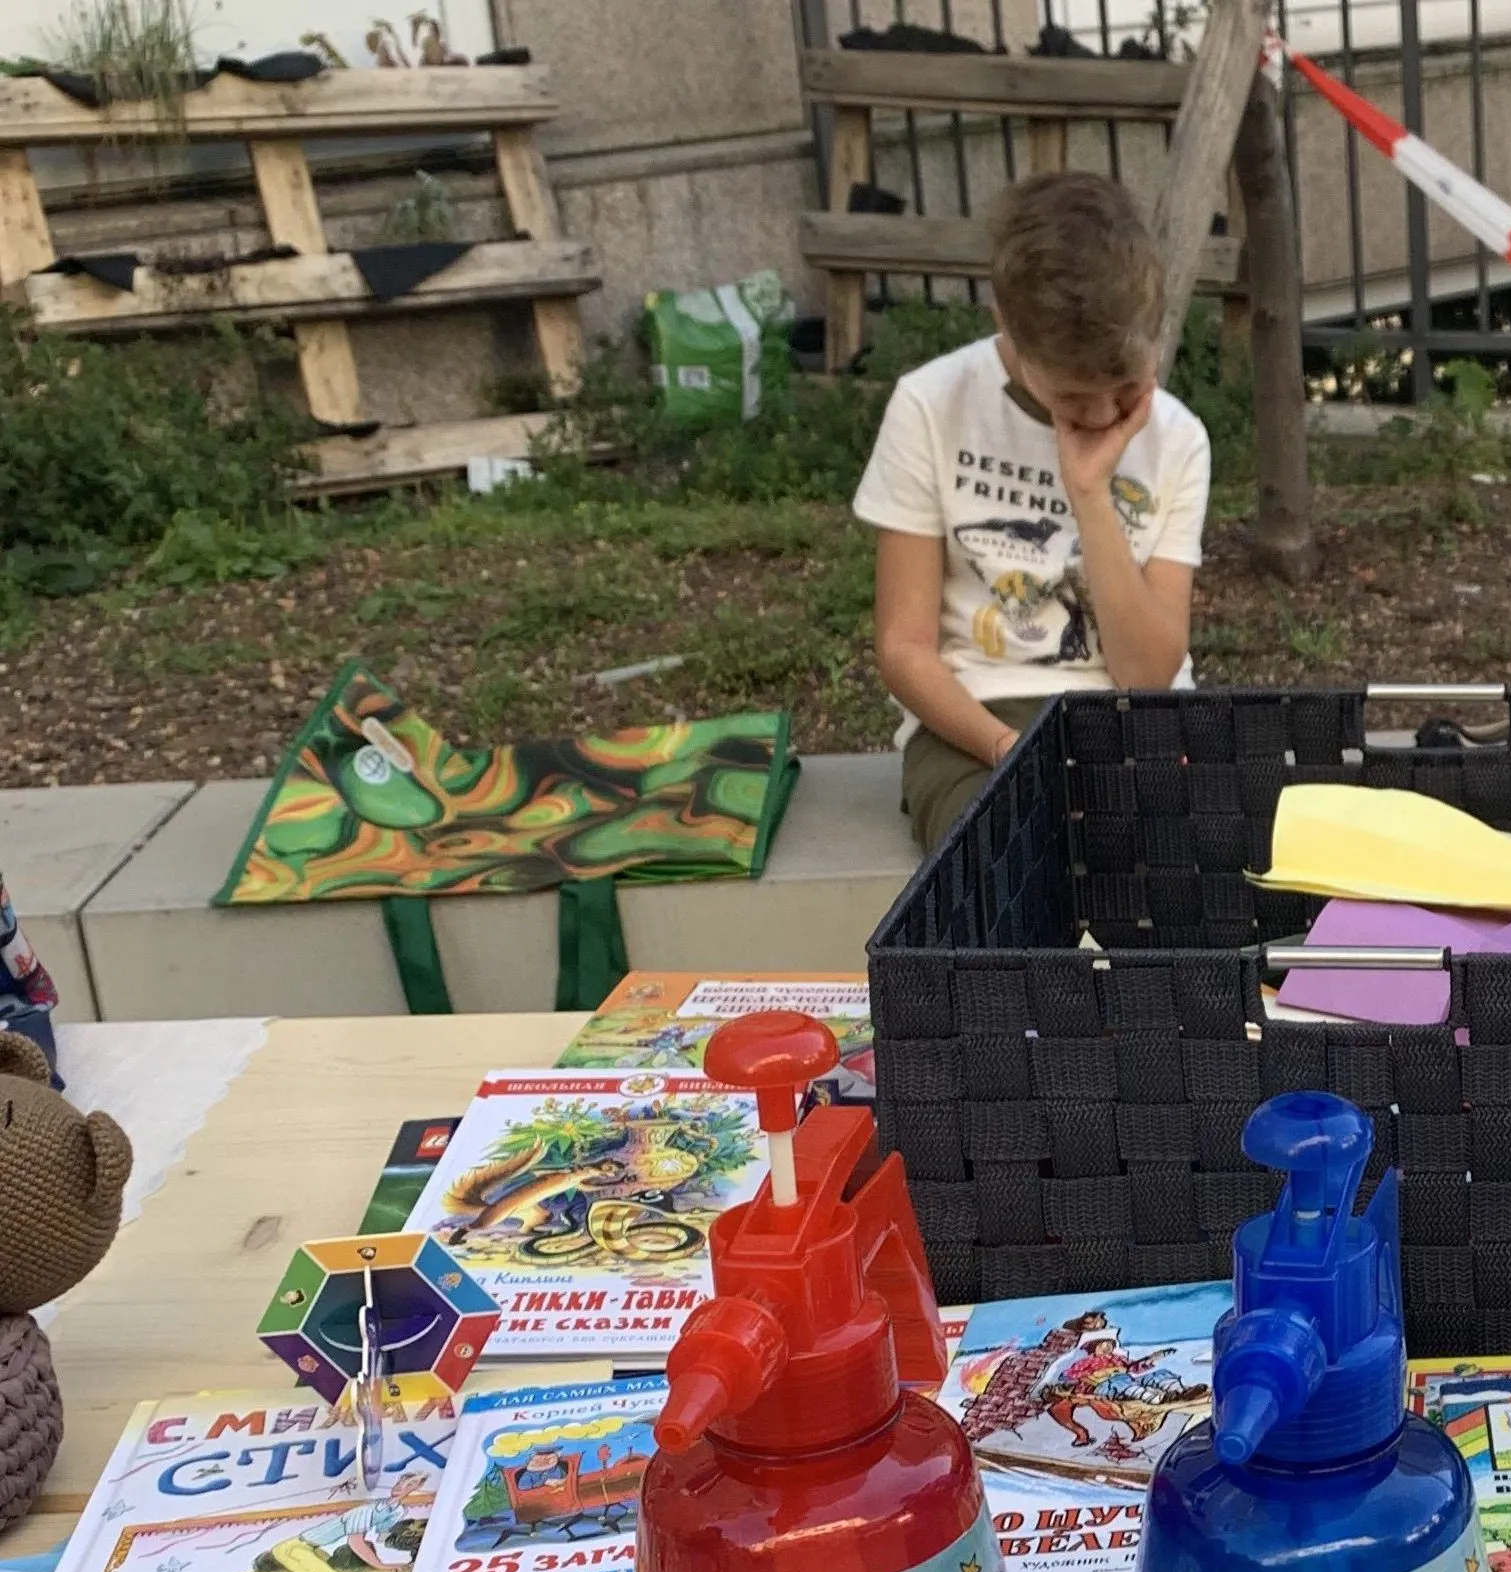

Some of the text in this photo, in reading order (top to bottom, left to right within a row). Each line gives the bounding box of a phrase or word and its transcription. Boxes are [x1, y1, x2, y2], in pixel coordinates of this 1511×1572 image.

[957, 449, 1055, 488] DESER
[954, 474, 1069, 515] FRIEND
[511, 1401, 603, 1422] Корней
[542, 1384, 617, 1400] САМЫХ
[204, 1395, 457, 1441] МИХАЛ
[156, 1428, 457, 1496] СТИХ
[532, 1543, 636, 1572] ЗАГА
